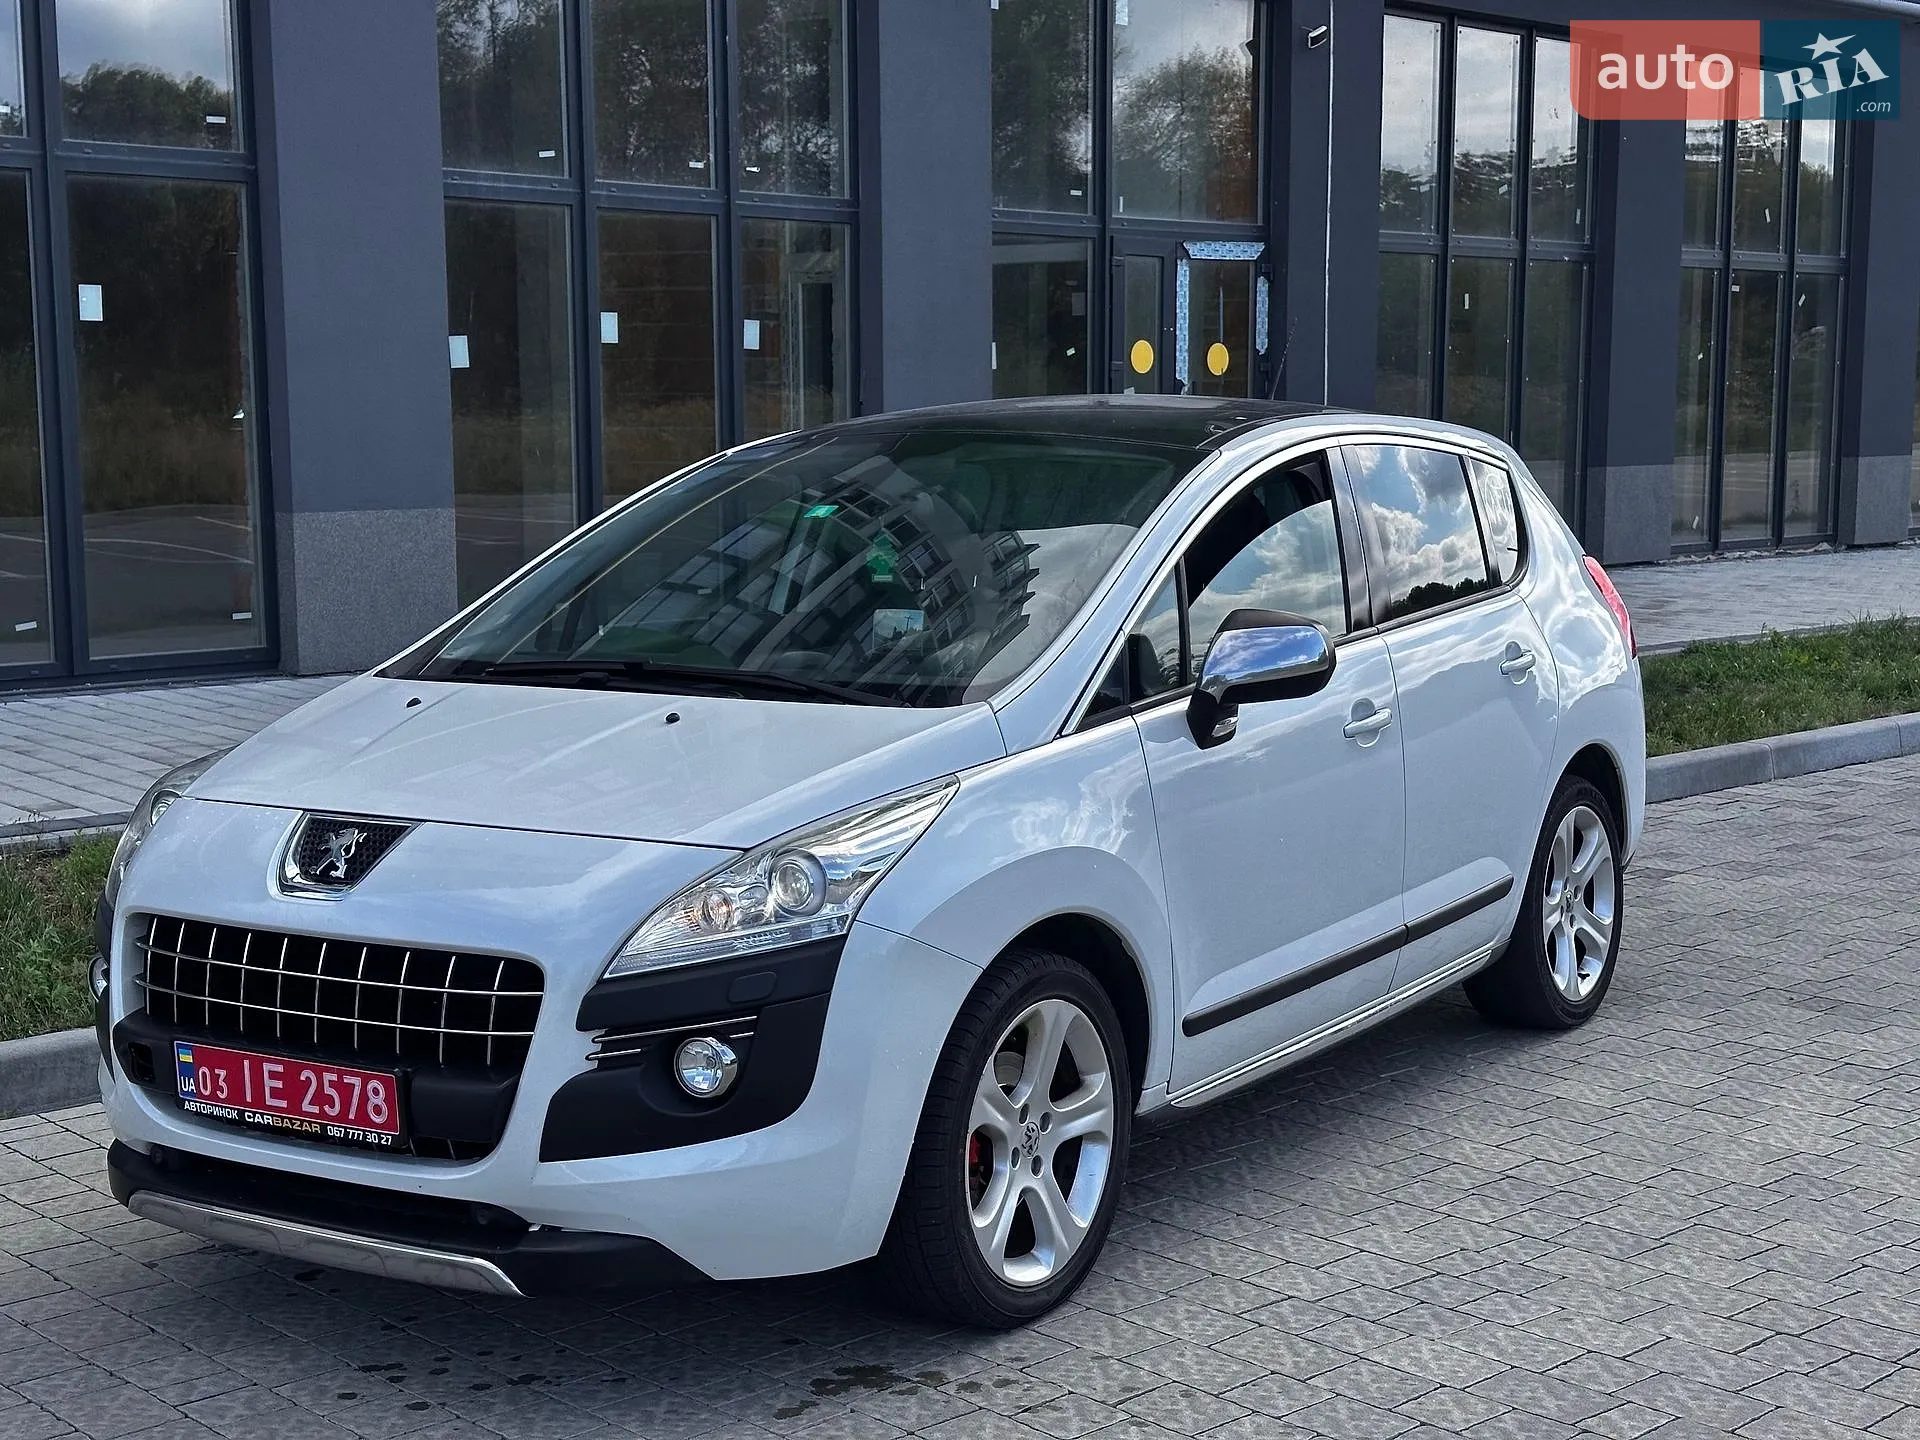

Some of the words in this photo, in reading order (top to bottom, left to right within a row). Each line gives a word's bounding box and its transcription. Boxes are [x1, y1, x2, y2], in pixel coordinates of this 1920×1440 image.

[181, 1076, 197, 1093] UA
[198, 1066, 228, 1099] 03
[243, 1059, 288, 1108] IE
[299, 1069, 388, 1124] 2578
[184, 1100, 239, 1119] АВТОРИНОК
[244, 1111, 321, 1134] CARBAZAR
[327, 1126, 345, 1138] 067
[346, 1128, 364, 1141] 777
[365, 1131, 379, 1143] 30
[380, 1134, 392, 1146] 27
